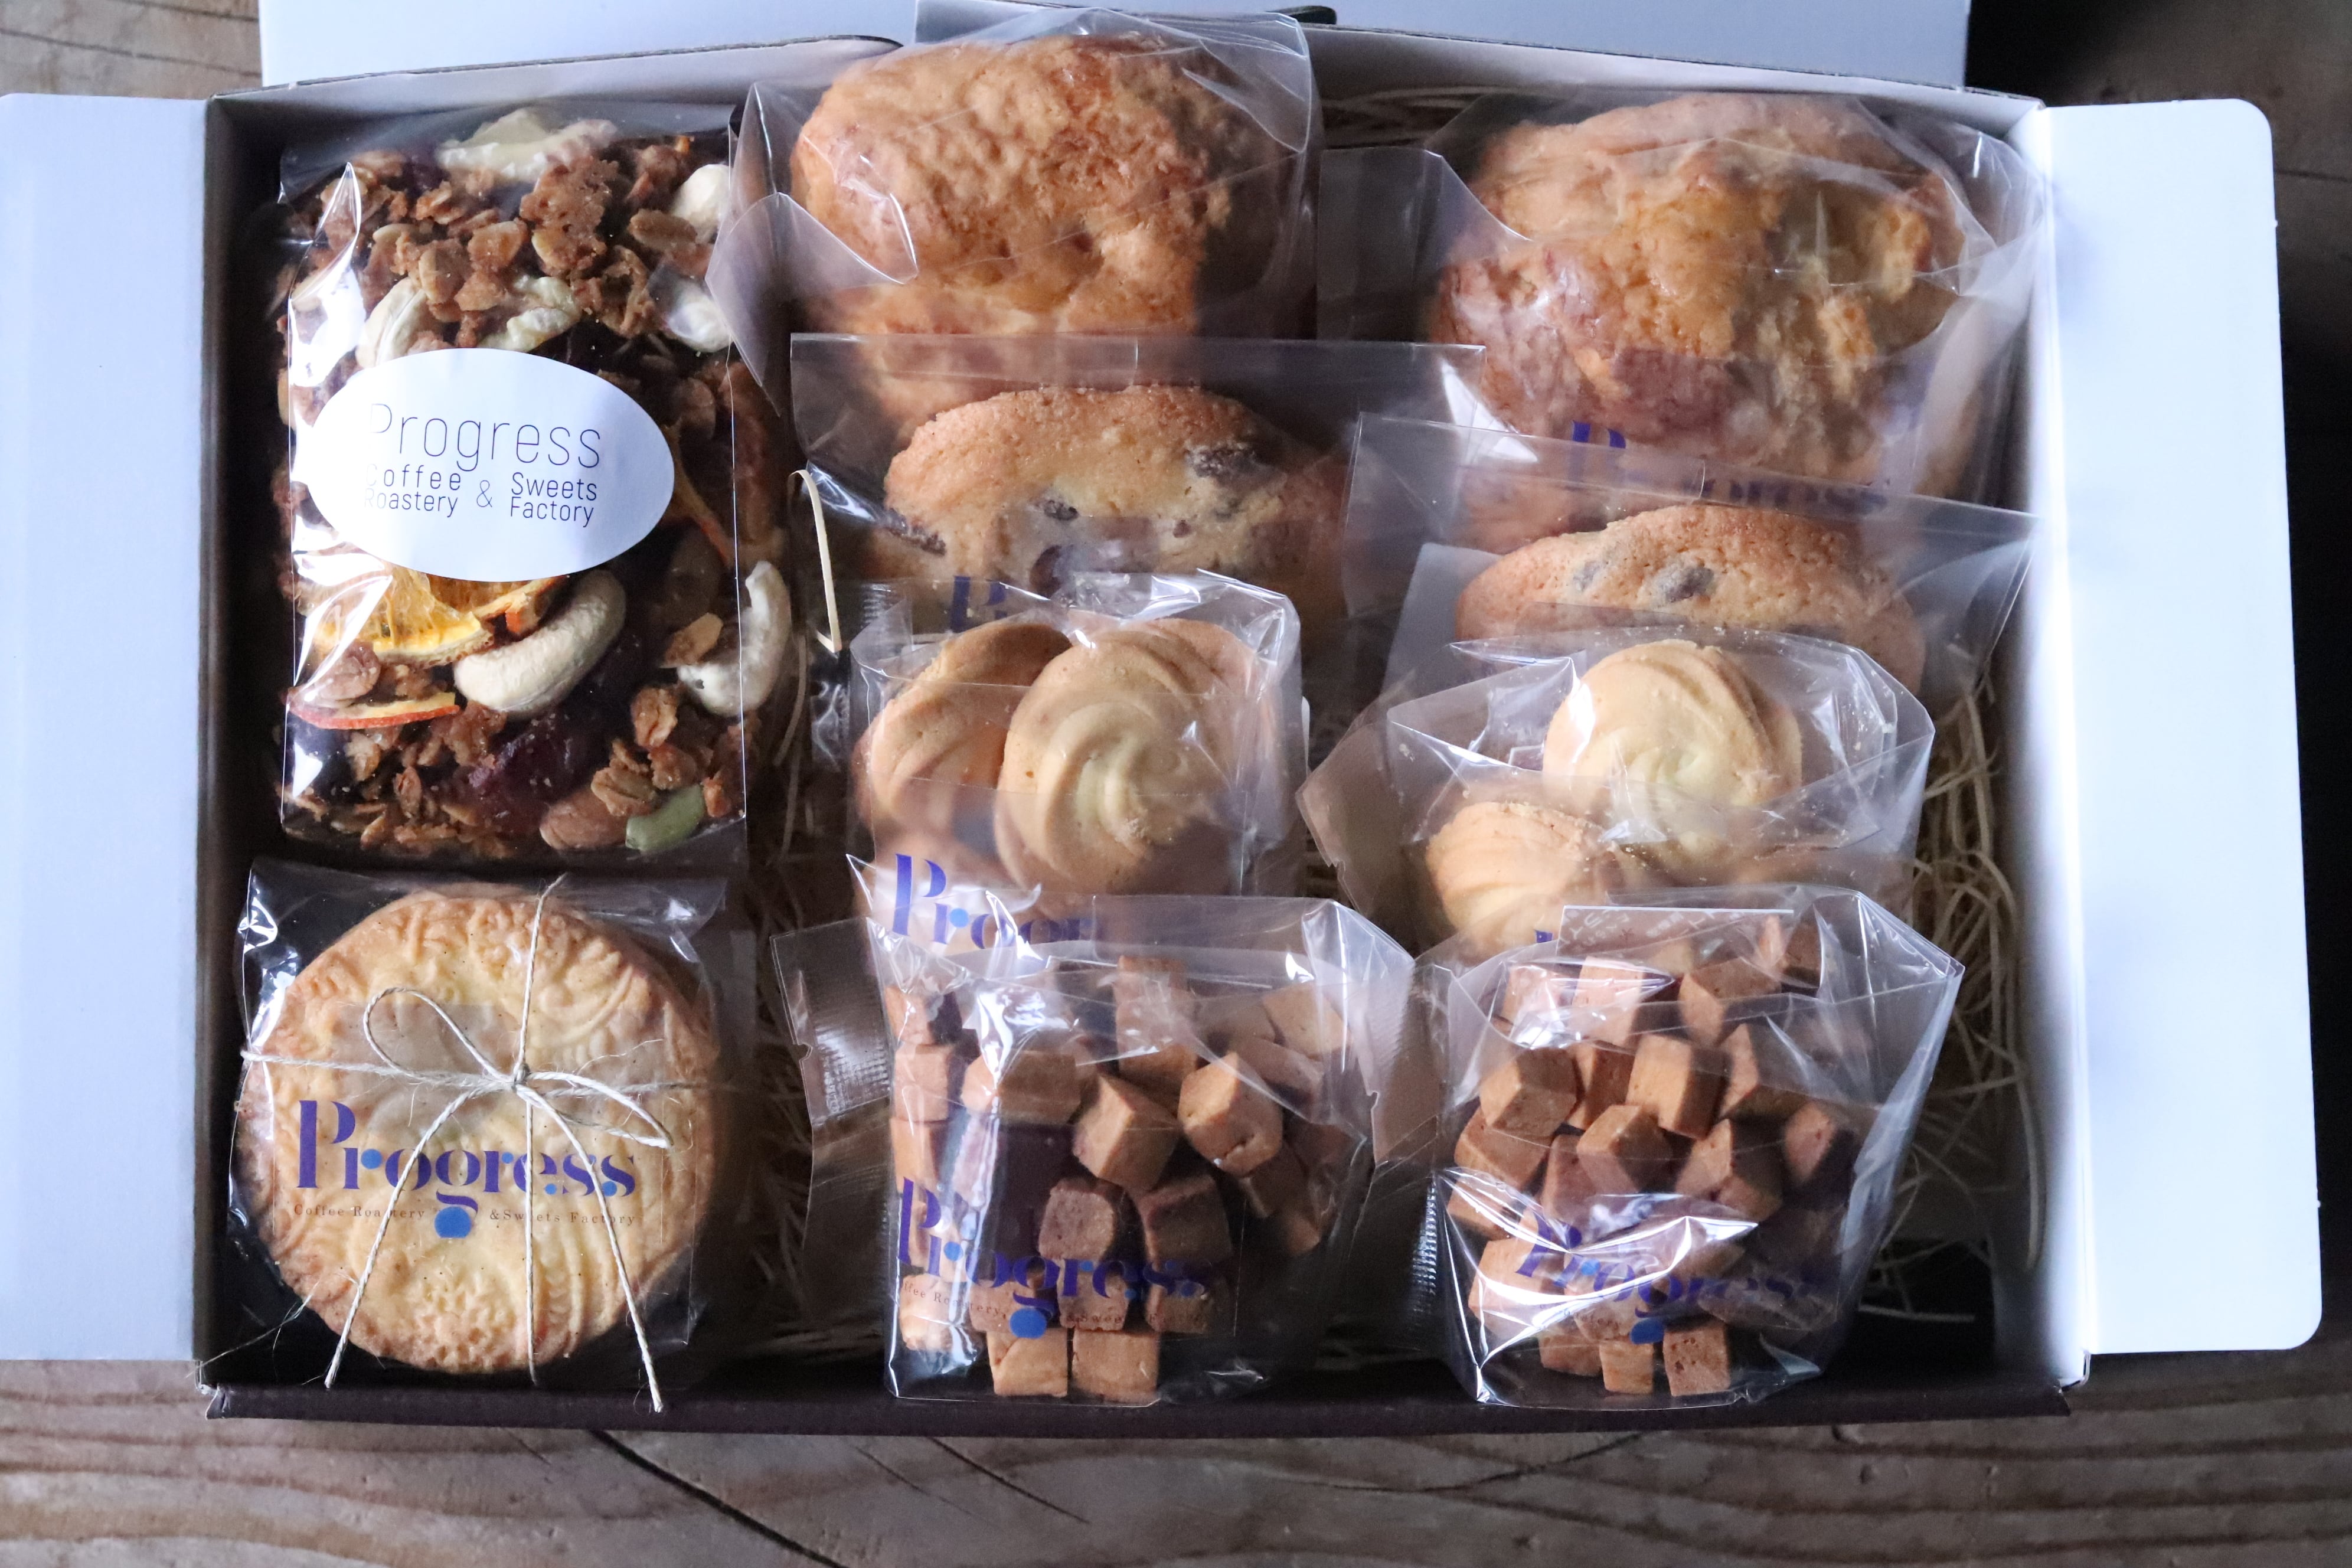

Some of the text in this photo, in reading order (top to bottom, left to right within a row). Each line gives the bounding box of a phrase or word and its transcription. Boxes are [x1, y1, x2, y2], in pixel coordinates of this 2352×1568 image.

[370, 403, 601, 472] Progress
[364, 479, 594, 528] Roastery & Factory
[365, 463, 598, 501] Coffee Sweets
[296, 1099, 636, 1239] Progress
[294, 1204, 345, 1217] Coffee
[354, 1205, 425, 1220] Roatery
